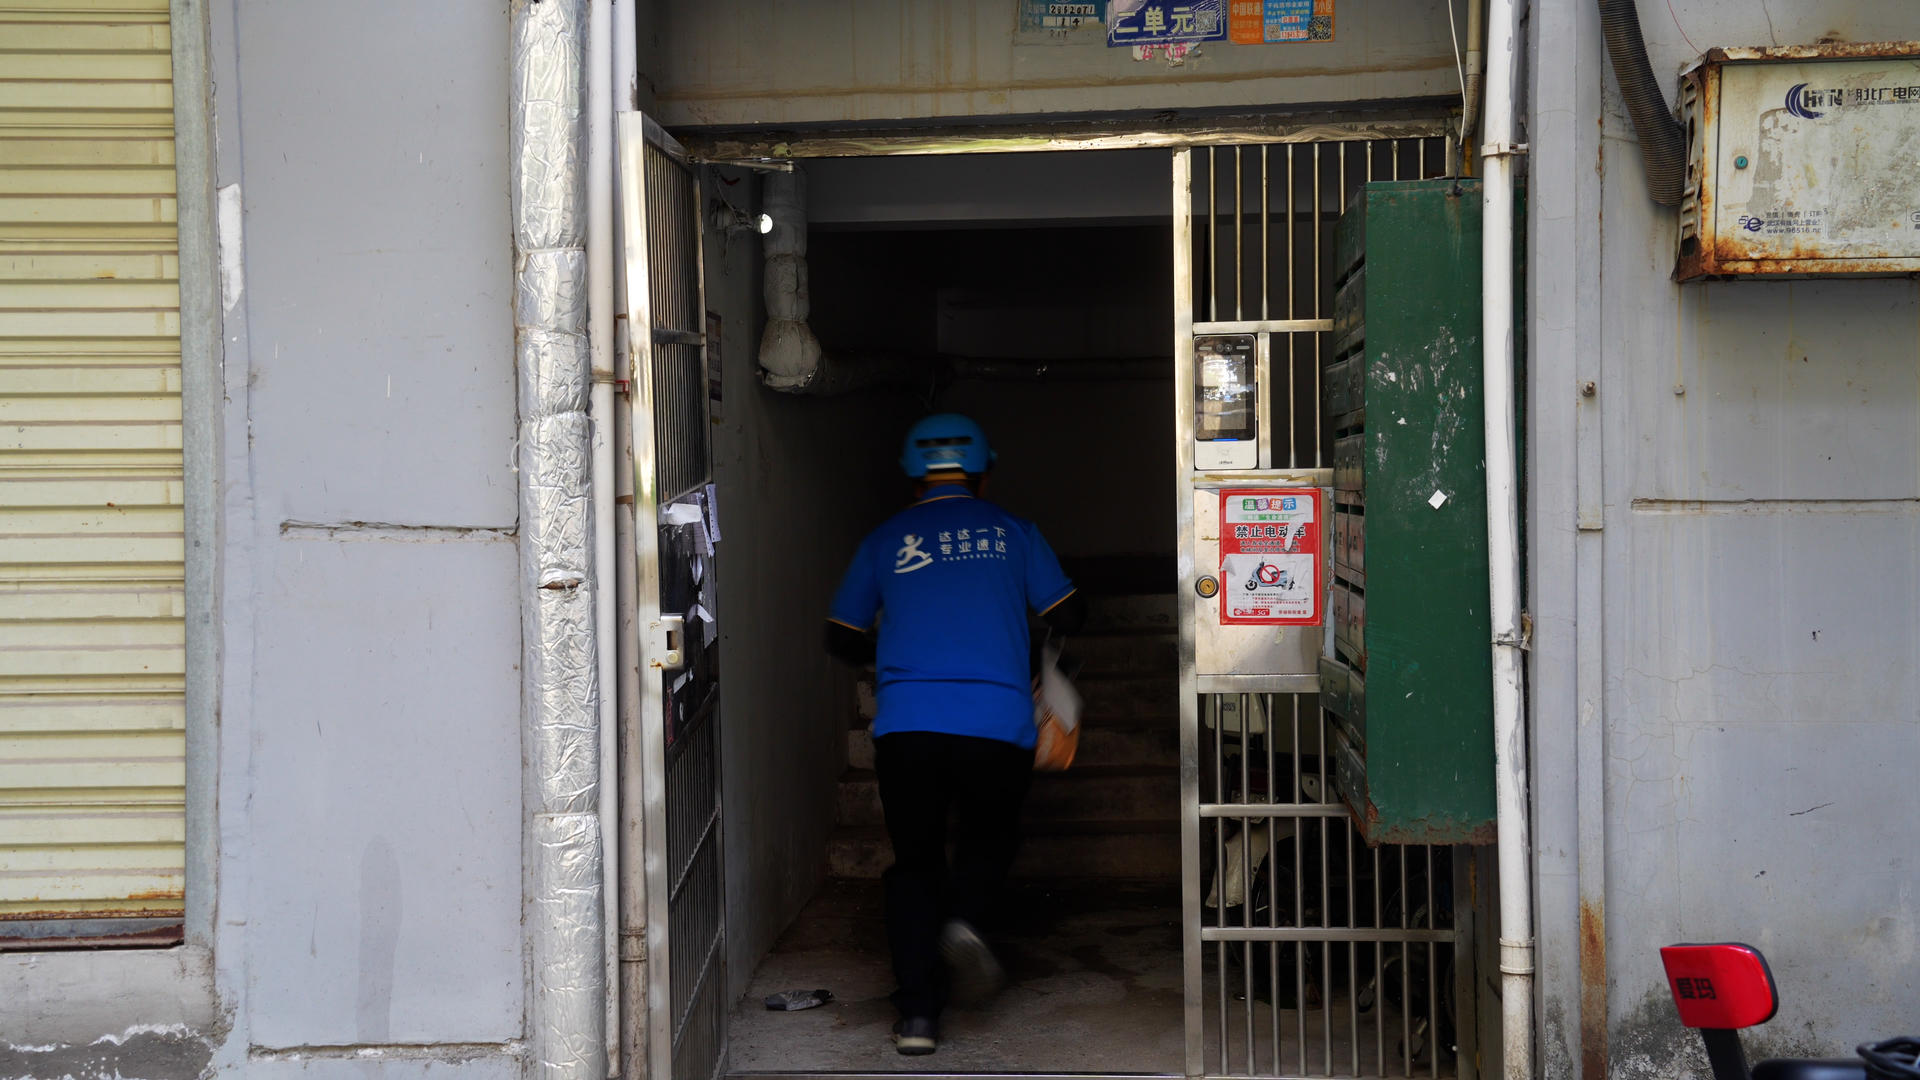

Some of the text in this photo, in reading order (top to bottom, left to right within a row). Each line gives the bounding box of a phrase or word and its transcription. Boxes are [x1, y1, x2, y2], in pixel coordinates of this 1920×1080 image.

[1116, 6, 1194, 35] 二单元
[1243, 498, 1296, 511] 温馨提示
[939, 526, 1006, 542] 达达一下
[1236, 525, 1305, 538] 禁止电动车
[940, 538, 1006, 555] 专业速达
[1676, 978, 1716, 1000] 爱玛
